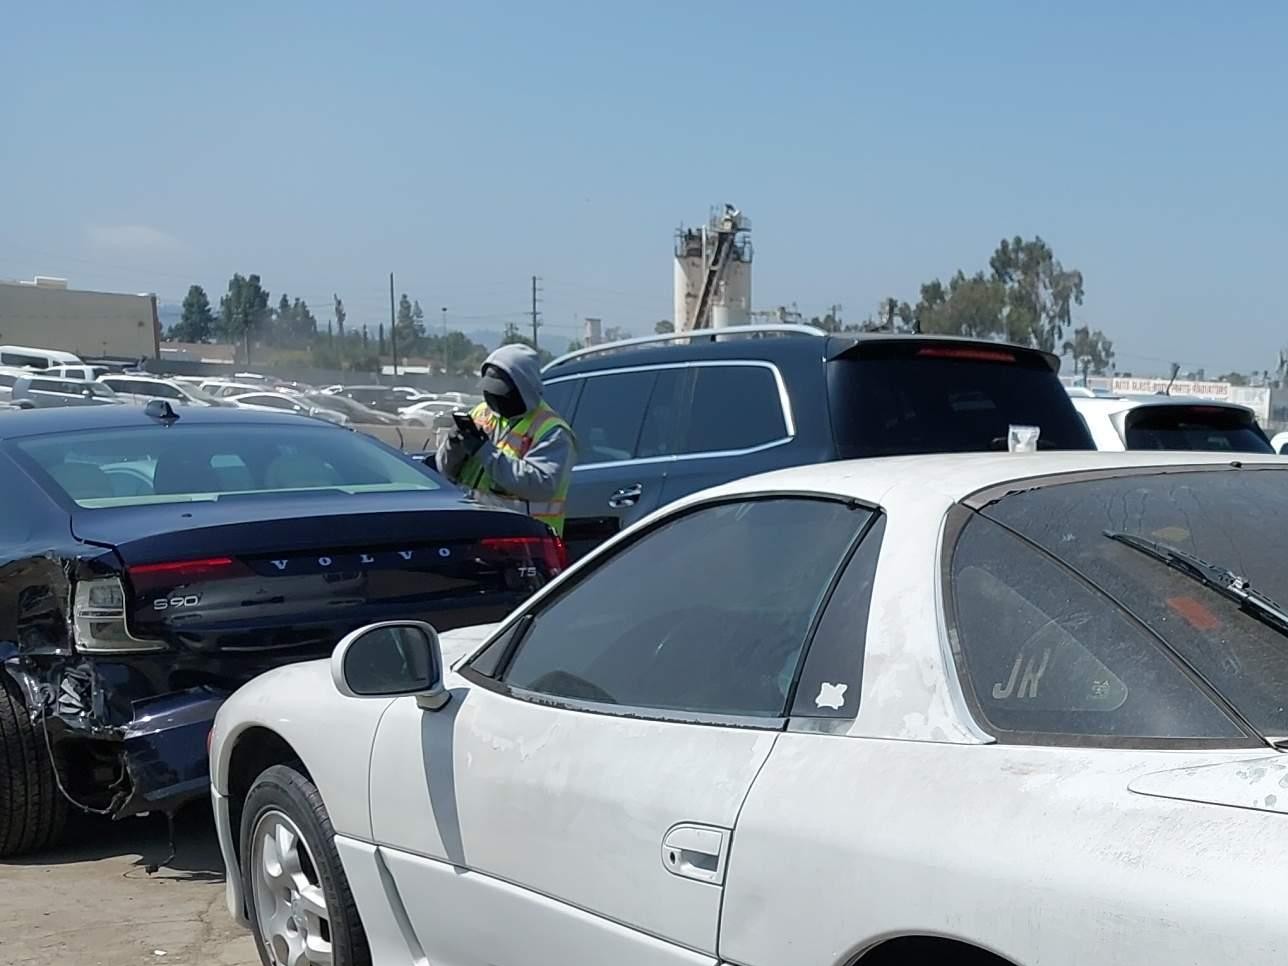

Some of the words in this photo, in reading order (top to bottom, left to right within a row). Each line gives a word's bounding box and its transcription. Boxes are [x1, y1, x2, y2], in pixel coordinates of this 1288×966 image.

[270, 547, 451, 570] VOLVO
[517, 566, 537, 578] T5
[152, 595, 201, 611] S90
